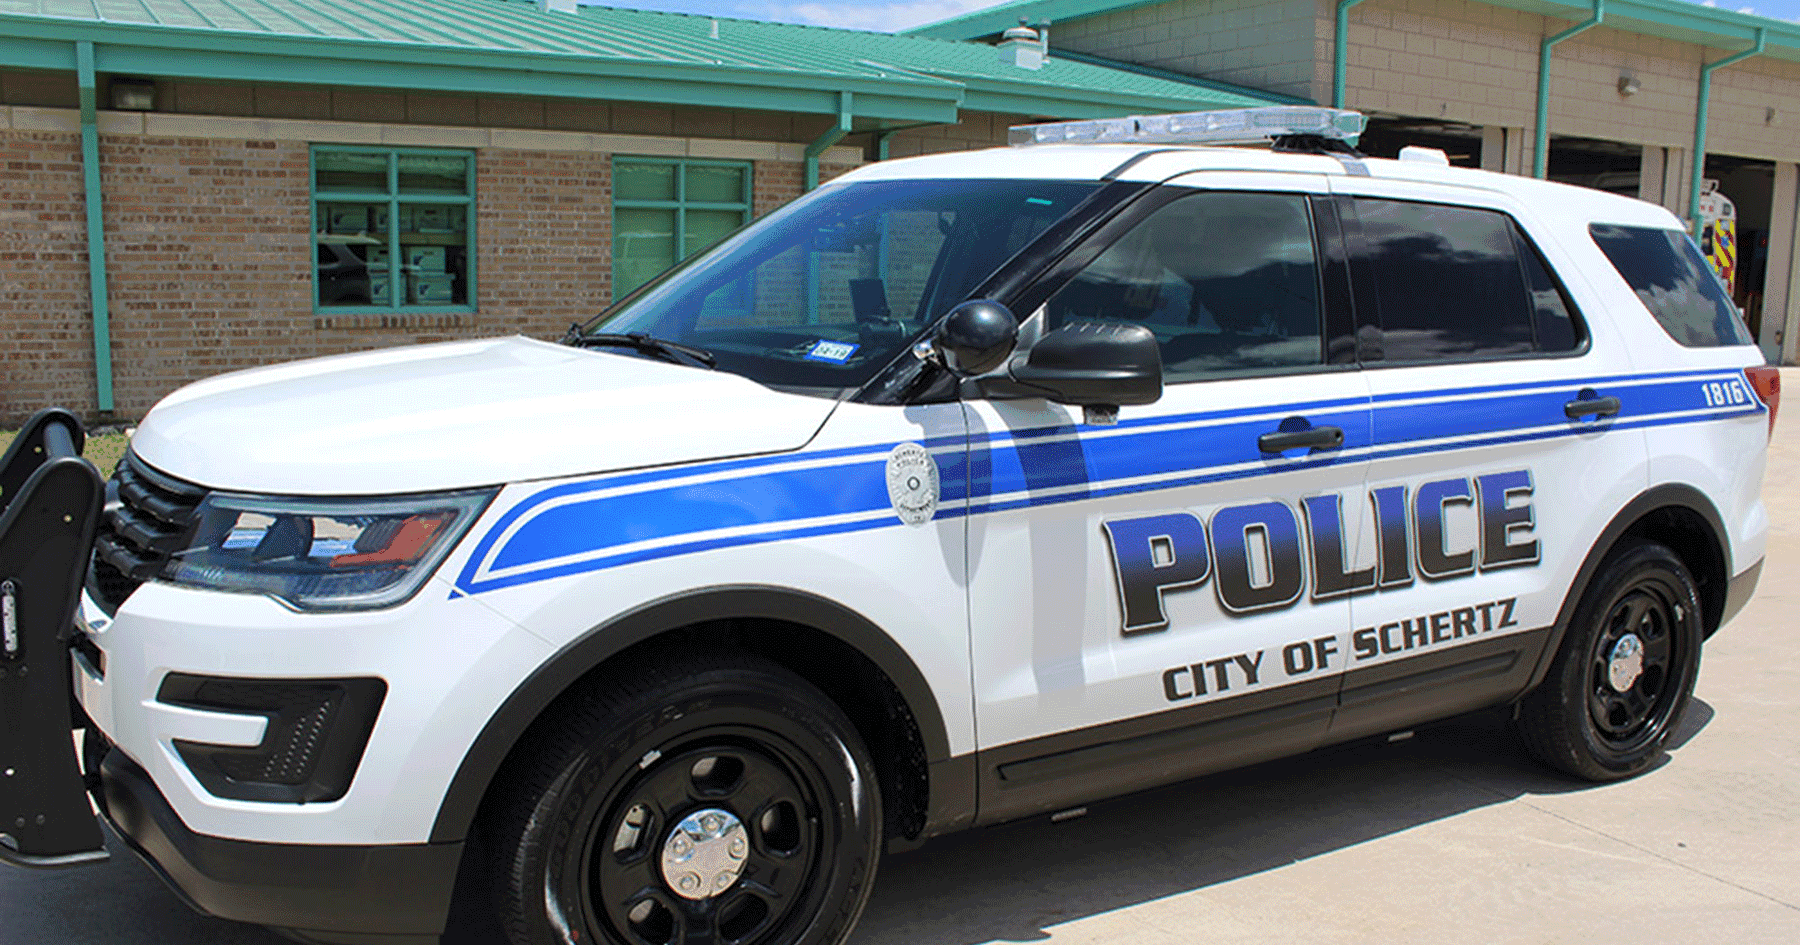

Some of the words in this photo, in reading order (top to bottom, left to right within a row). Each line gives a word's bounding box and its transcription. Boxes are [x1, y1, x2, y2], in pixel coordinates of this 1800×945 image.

[1701, 381, 1744, 406] 1816
[1102, 469, 1541, 633] POLICE
[1162, 650, 1264, 702] CITY
[1282, 635, 1340, 676] OF
[1353, 597, 1519, 661] SCHERTZ
